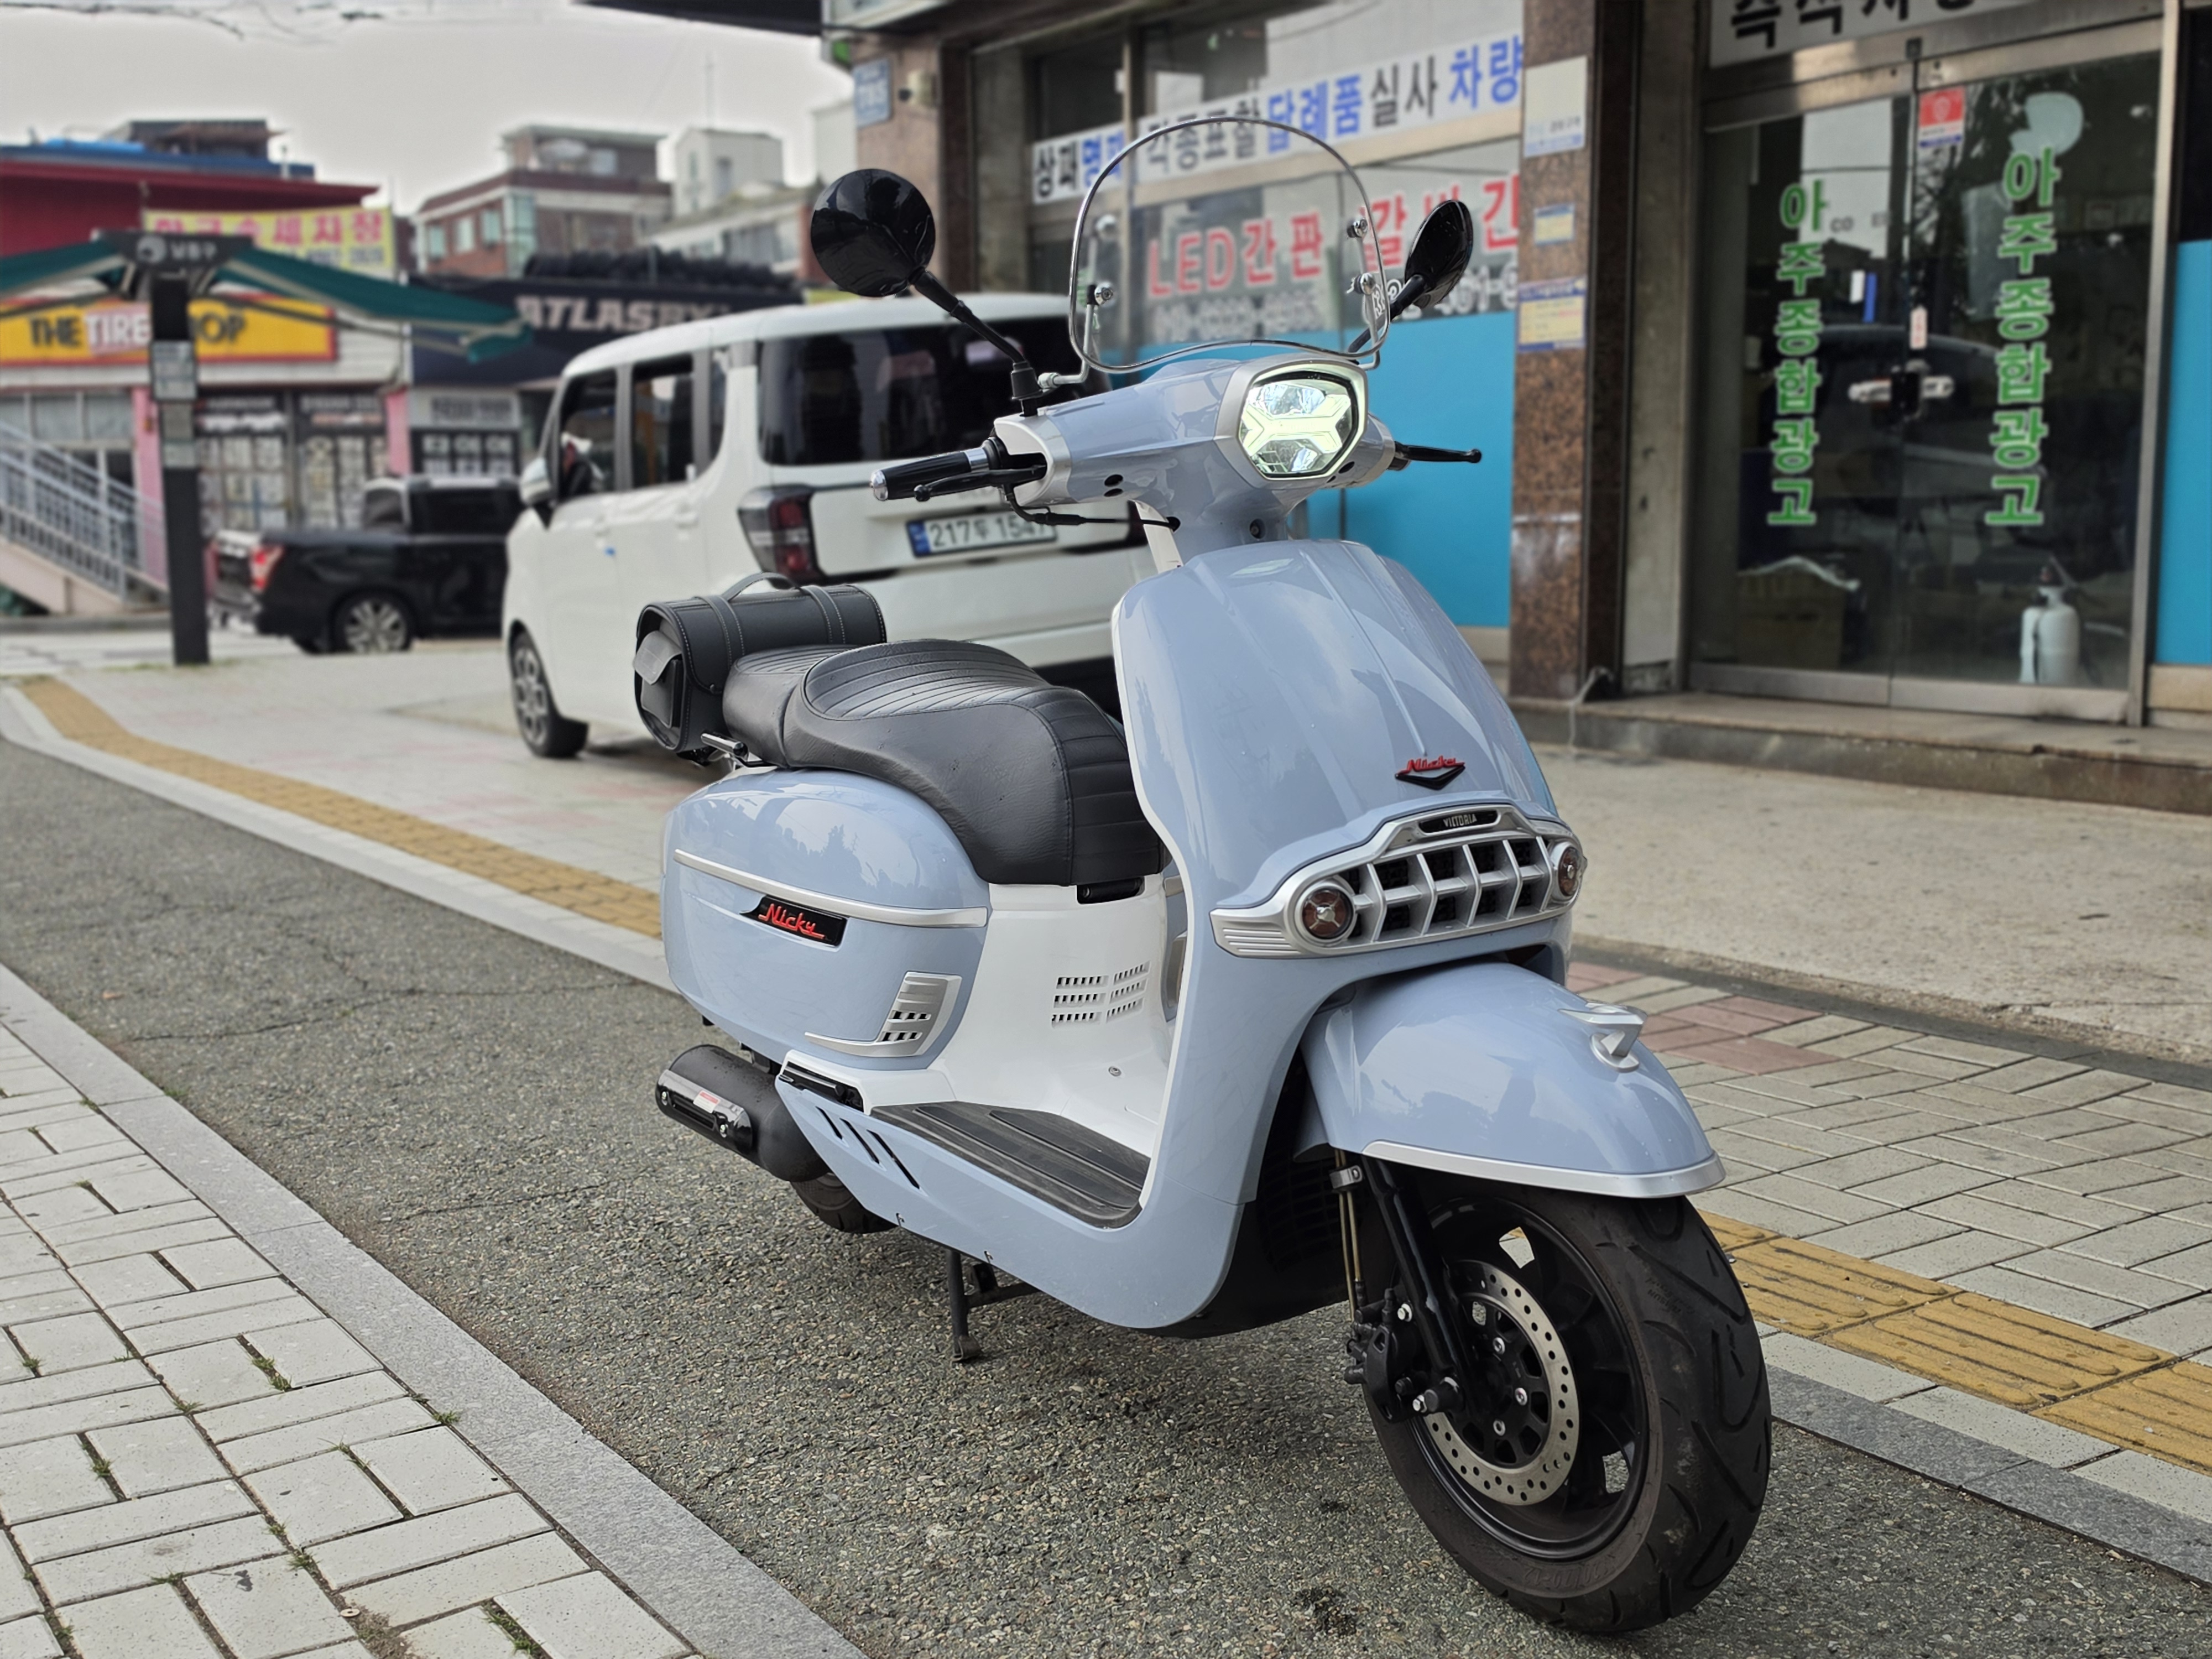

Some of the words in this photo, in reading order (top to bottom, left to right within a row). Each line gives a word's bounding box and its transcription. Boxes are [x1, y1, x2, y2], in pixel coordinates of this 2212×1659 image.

[1370, 55, 1437, 128] 실사
[1449, 35, 1522, 109] 차량
[30, 316, 81, 348] THE
[84, 313, 149, 347] TIRE
[1768, 179, 1828, 525] 아주종합광고
[1985, 145, 2061, 525] 아주종합광고
[1442, 813, 1478, 828] VICTORIA
[758, 902, 826, 940] Nicky
